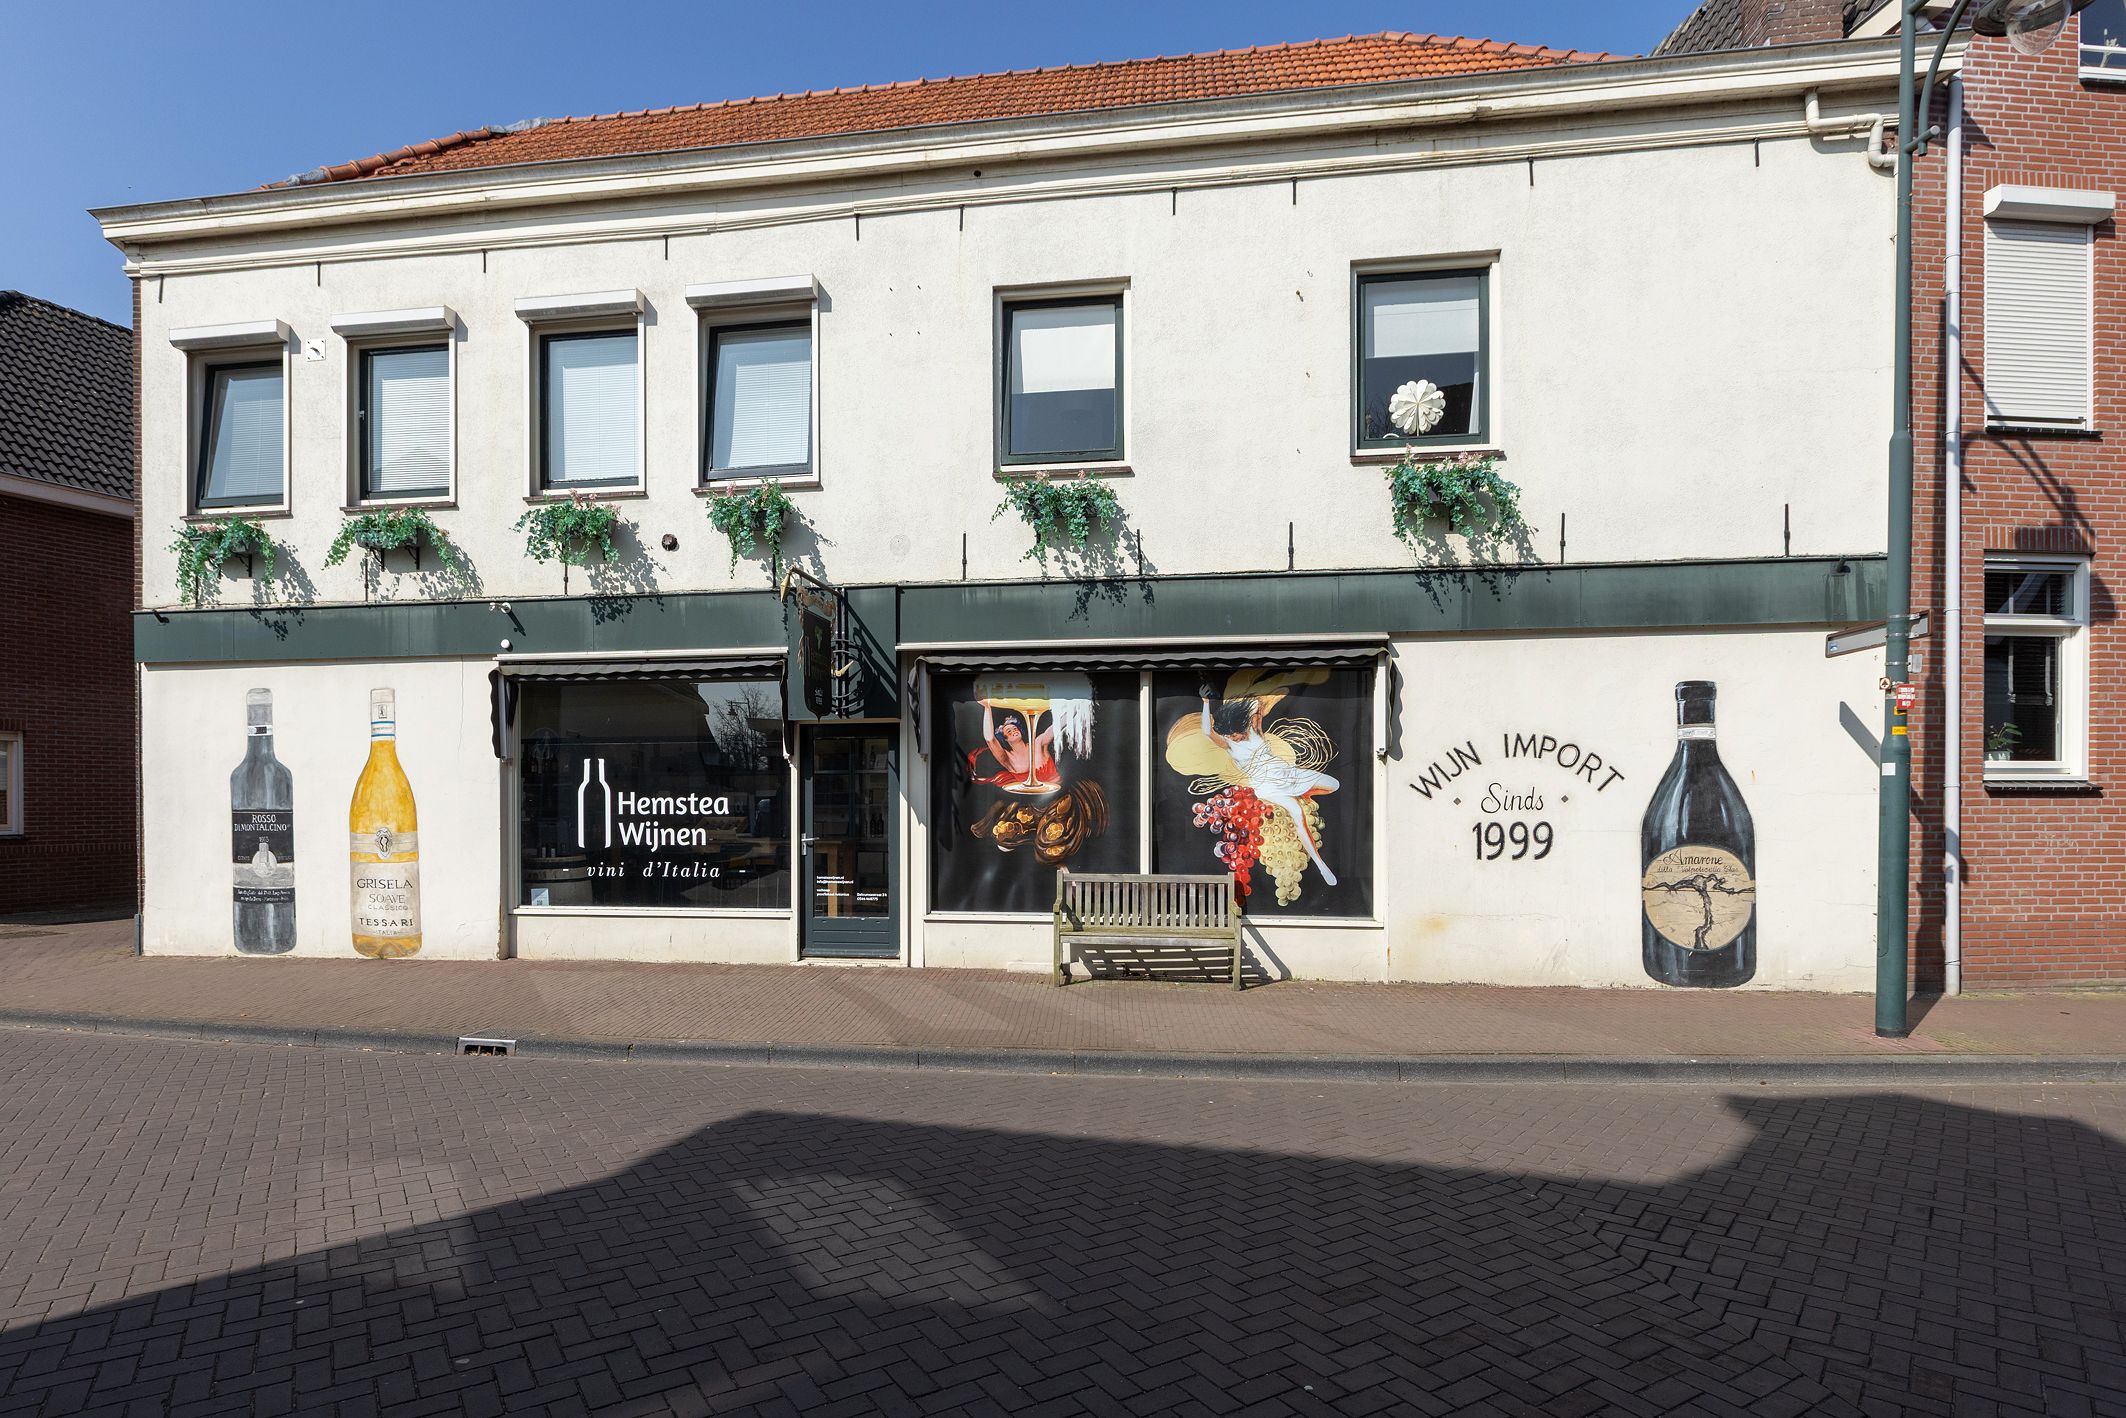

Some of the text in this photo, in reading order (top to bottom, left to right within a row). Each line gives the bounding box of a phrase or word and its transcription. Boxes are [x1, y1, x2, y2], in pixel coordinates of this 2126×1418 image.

[1409, 733, 1625, 799] WIJN IMPORT
[618, 791, 730, 816] Hemstea
[1480, 782, 1544, 813] Sinds
[251, 814, 277, 823] ROSSO
[618, 821, 707, 853] Wijnen
[1472, 821, 1554, 860] 1999
[1662, 848, 1723, 866] Amarone
[586, 861, 625, 878] vini
[356, 878, 413, 890] GRISELA
[369, 893, 406, 904] SOAVE
